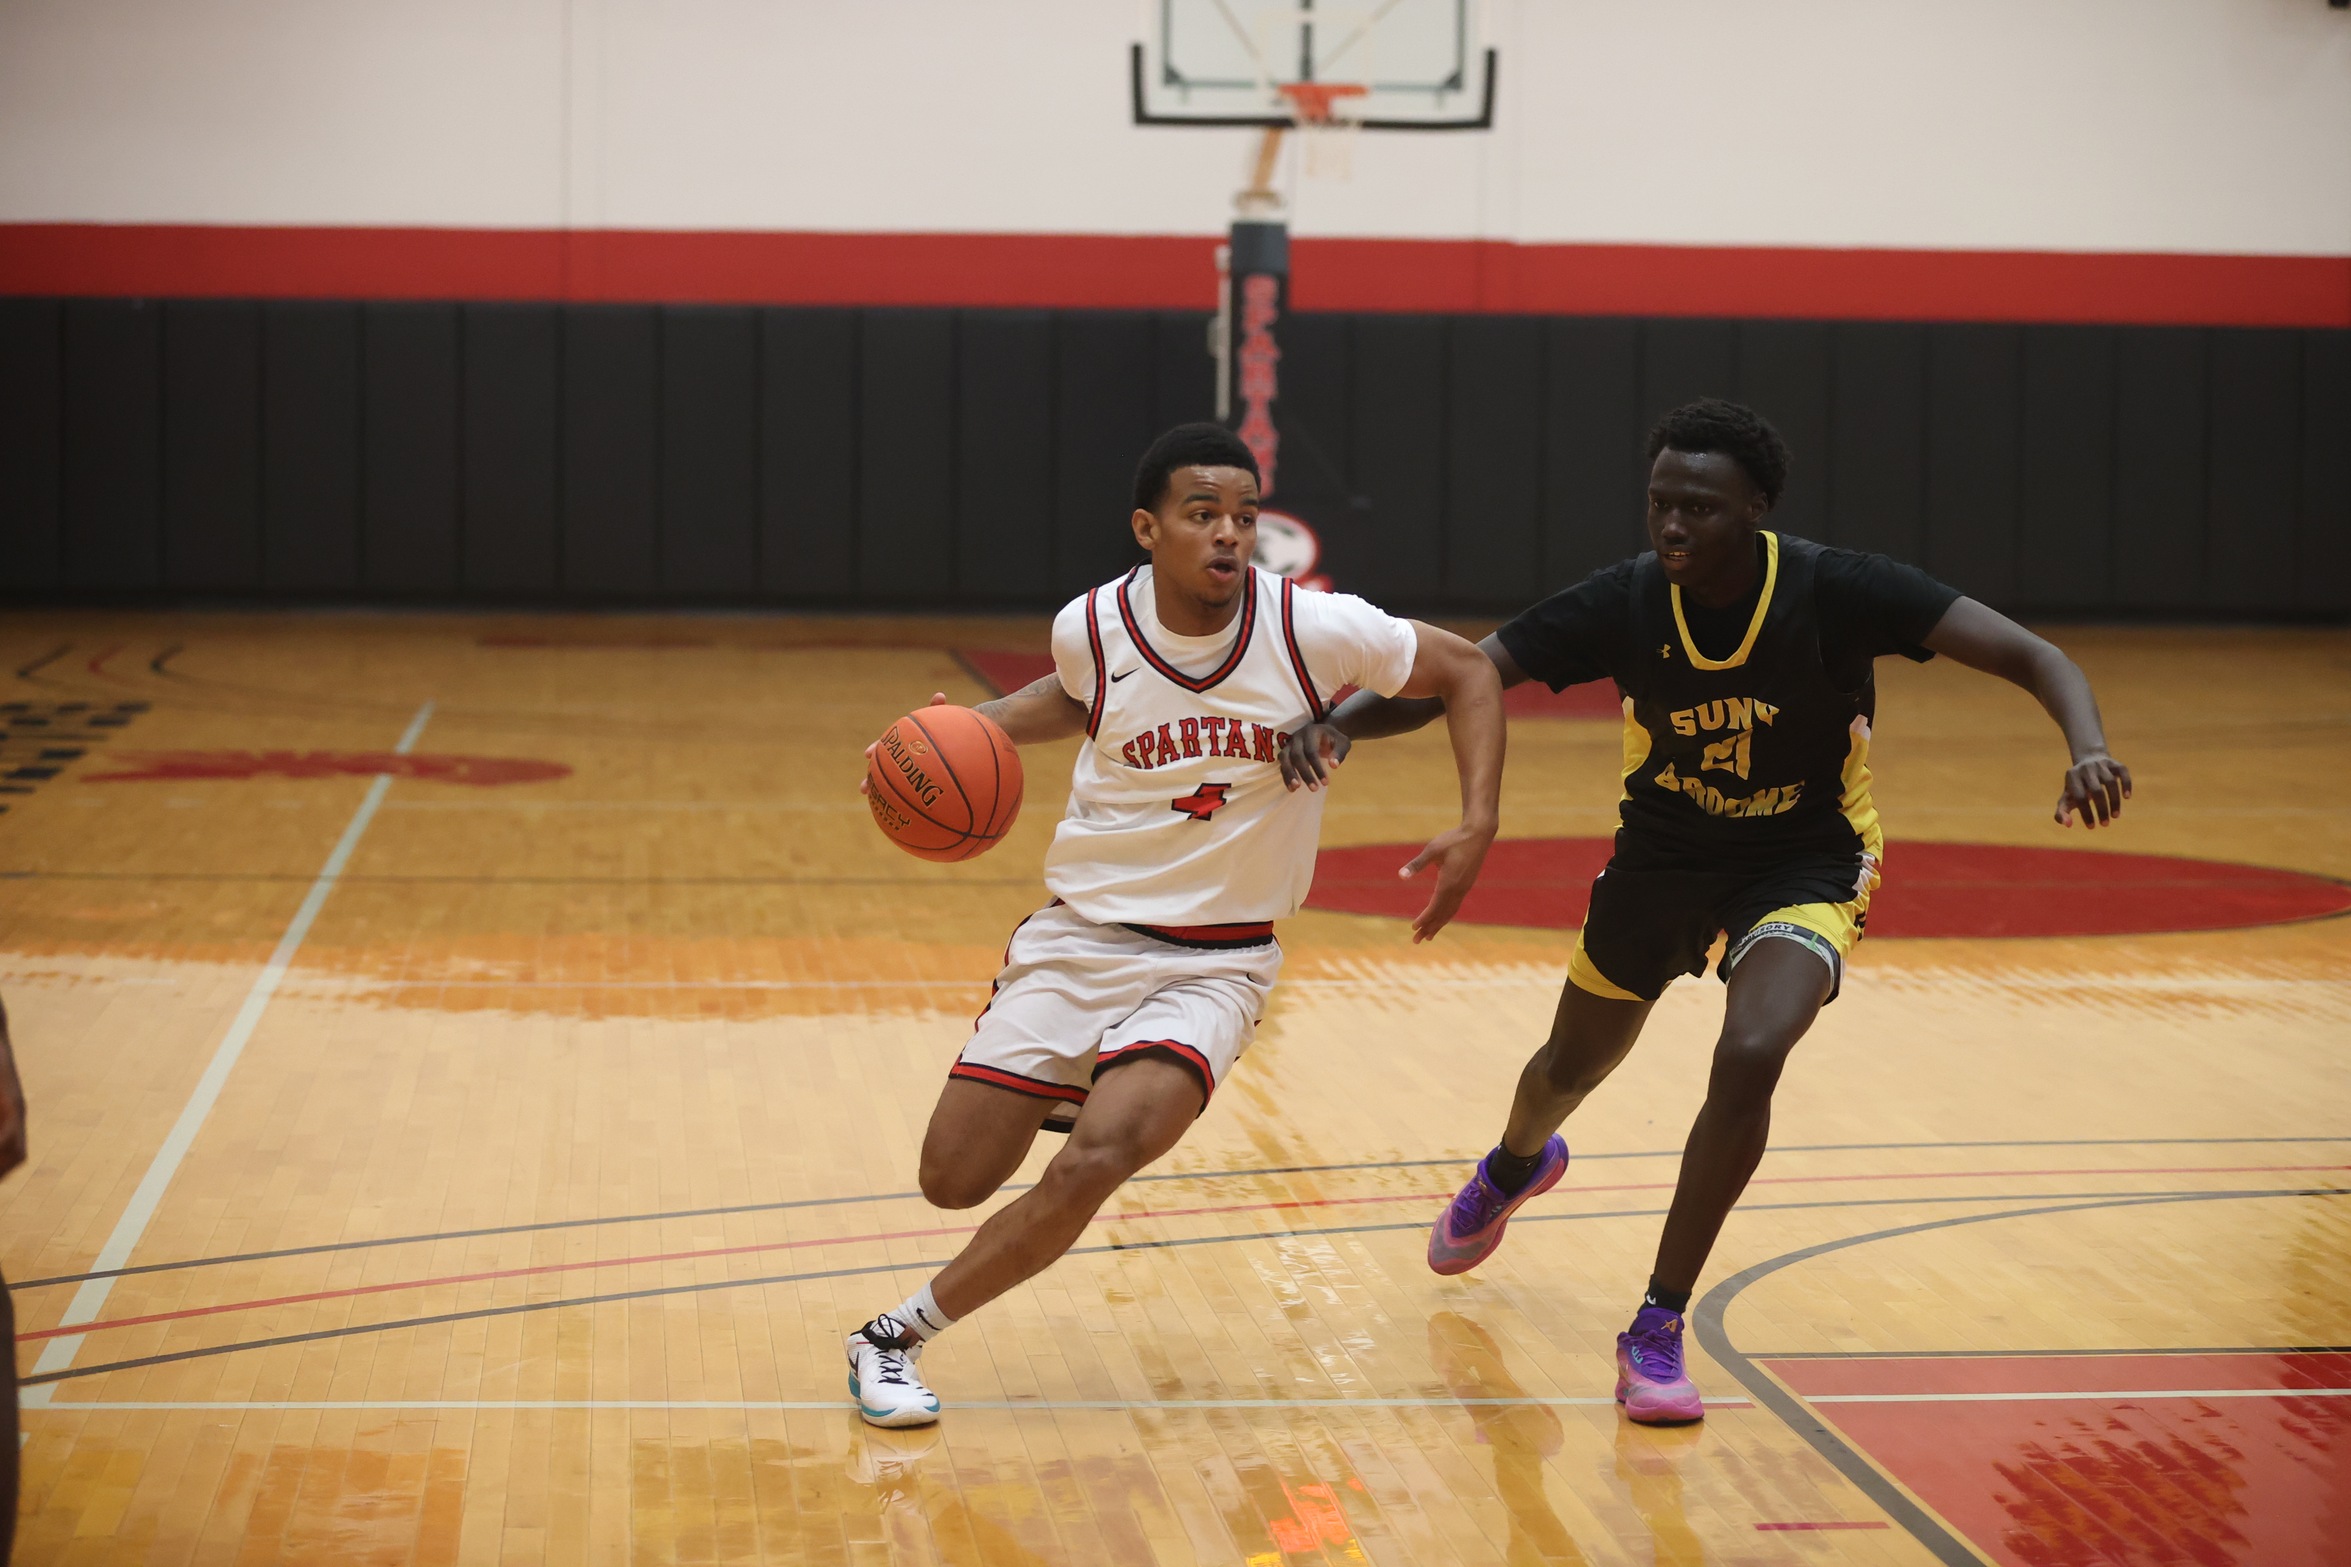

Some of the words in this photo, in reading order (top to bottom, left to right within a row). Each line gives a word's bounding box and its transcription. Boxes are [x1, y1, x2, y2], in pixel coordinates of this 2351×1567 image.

[880, 725, 944, 808] SPALDING
[1700, 729, 1754, 780] 21
[1171, 783, 1232, 821] 4
